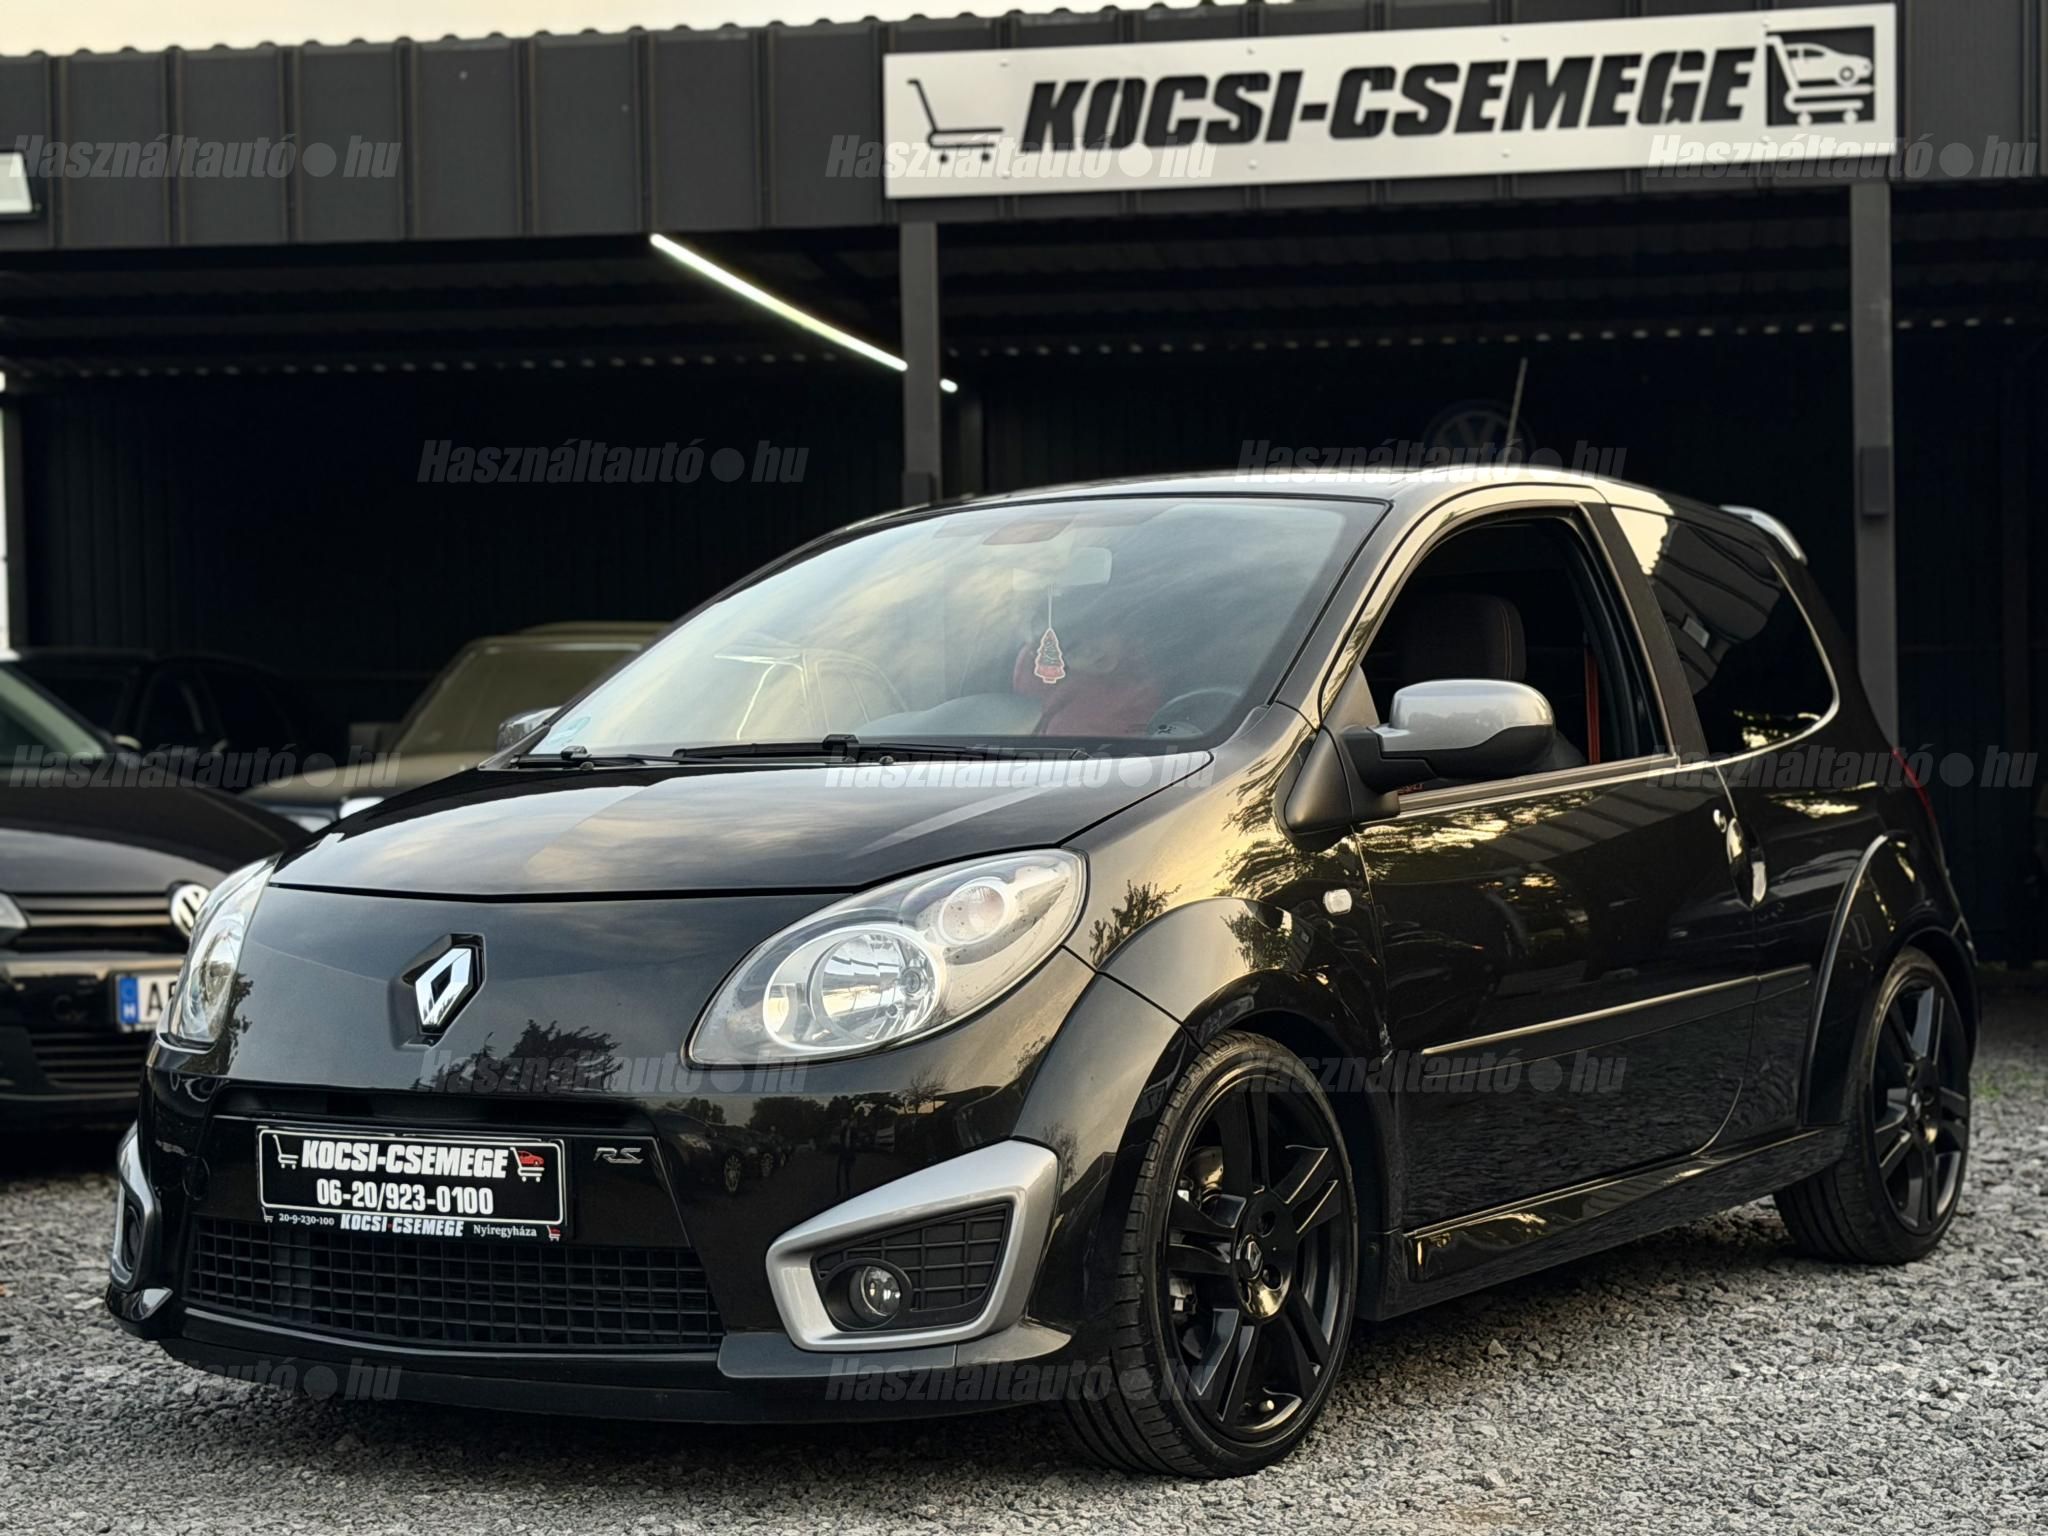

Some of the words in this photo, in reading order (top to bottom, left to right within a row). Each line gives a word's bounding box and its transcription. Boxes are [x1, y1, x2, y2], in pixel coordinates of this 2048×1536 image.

[1020, 47, 1755, 153] KOCSI-CSEMEGE
[301, 1139, 509, 1178] KOCSI-CSEMEGE
[593, 1146, 644, 1164] RS
[316, 1178, 494, 1215] 06-20/923-0100
[278, 1212, 335, 1226] 20-9-230-100
[473, 1223, 537, 1237] Nyíregyháza
